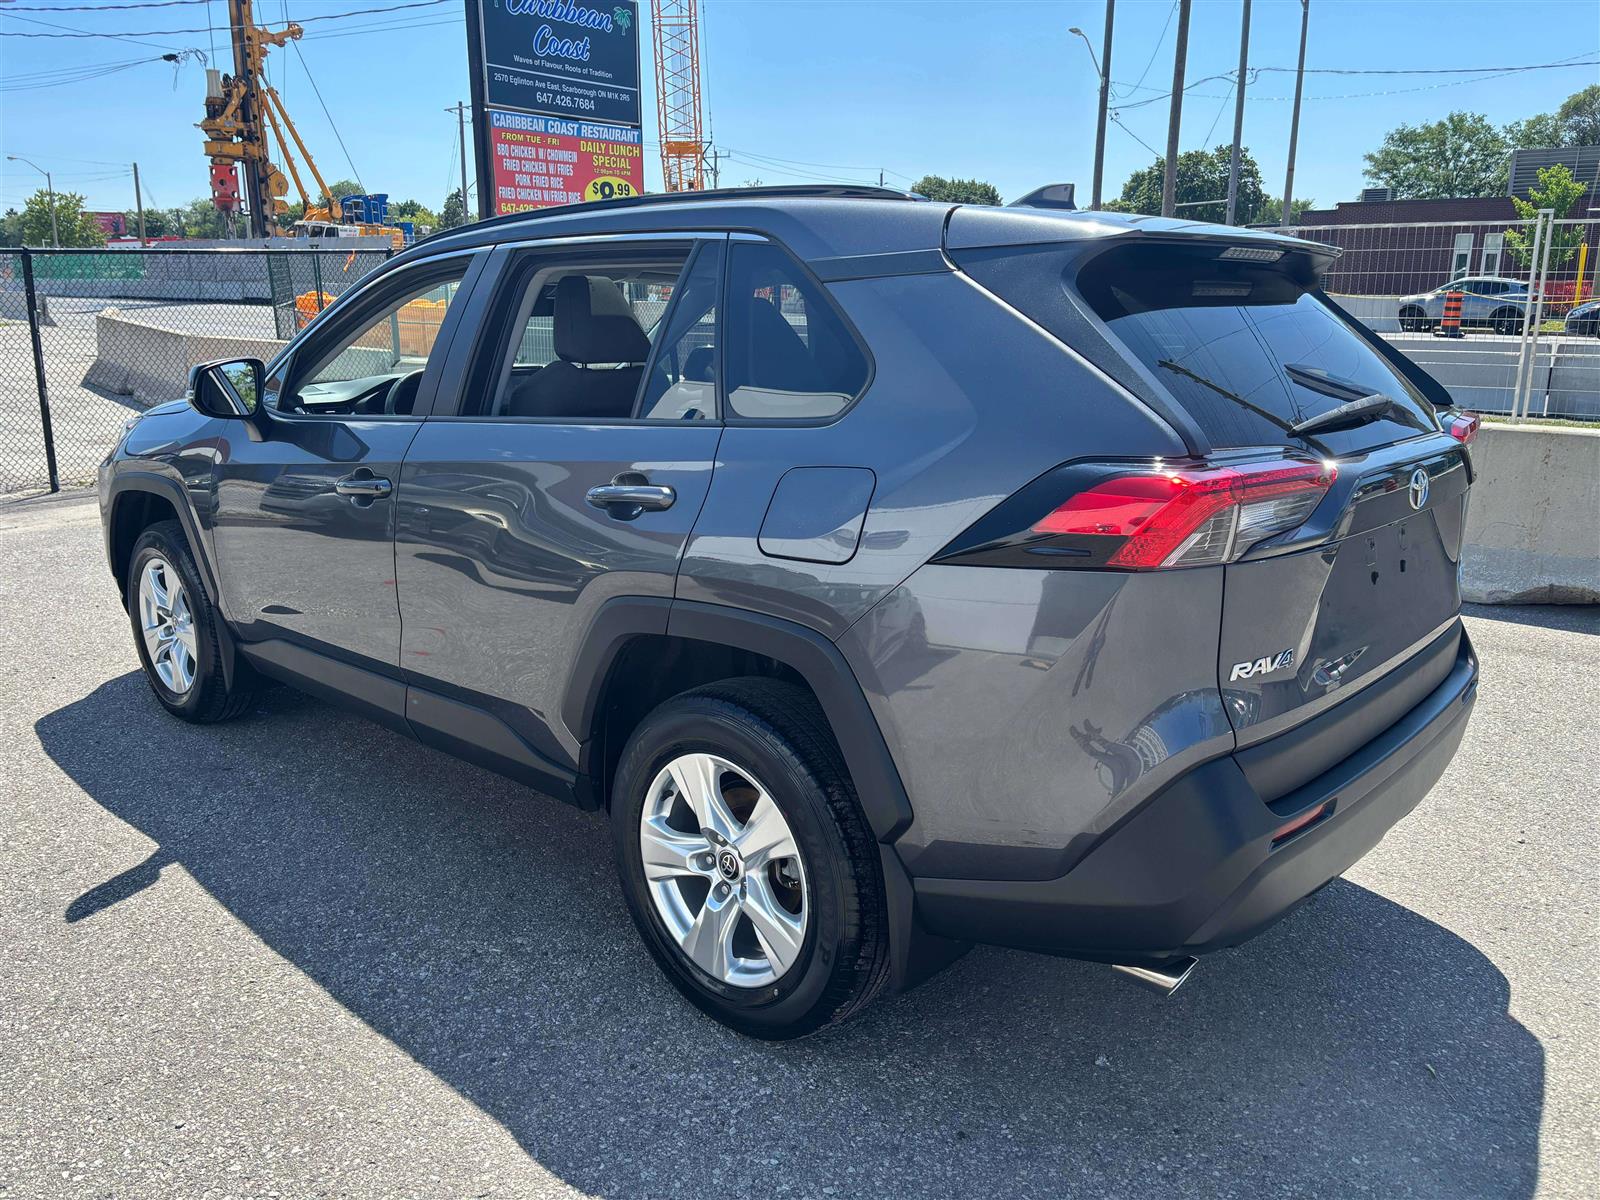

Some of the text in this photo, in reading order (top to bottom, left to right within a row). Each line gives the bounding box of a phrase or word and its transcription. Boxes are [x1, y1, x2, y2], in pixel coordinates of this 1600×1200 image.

[533, 24, 590, 61] Coast
[514, 54, 533, 64] Waves
[541, 60, 564, 71] Flavour,
[565, 64, 581, 73] Roots
[589, 68, 613, 78] Tradition
[494, 72, 630, 102] 2570 Eglinton Ave East, Scarborough ON M1K 2R5
[536, 91, 595, 110] 647.426.7684
[493, 113, 639, 143] CARIBBEAN COAST RESTAURANT
[501, 132, 524, 142] FROM
[526, 135, 541, 144] TUE
[547, 137, 560, 146] FRI
[497, 143, 509, 158] BBQ
[510, 144, 536, 159] CHICKEN
[580, 140, 640, 157] DAILY LUNCH
[503, 158, 520, 172] FRIED
[521, 160, 547, 174] CHICKEN
[557, 163, 574, 176] FRIES
[592, 154, 631, 169] SPECIAL
[515, 173, 564, 189] PORK FRIED RICE
[498, 186, 516, 199] FRIED
[517, 188, 542, 201] CHICKEN
[568, 191, 581, 204] RICE
[1228, 647, 1294, 681] RAV4
